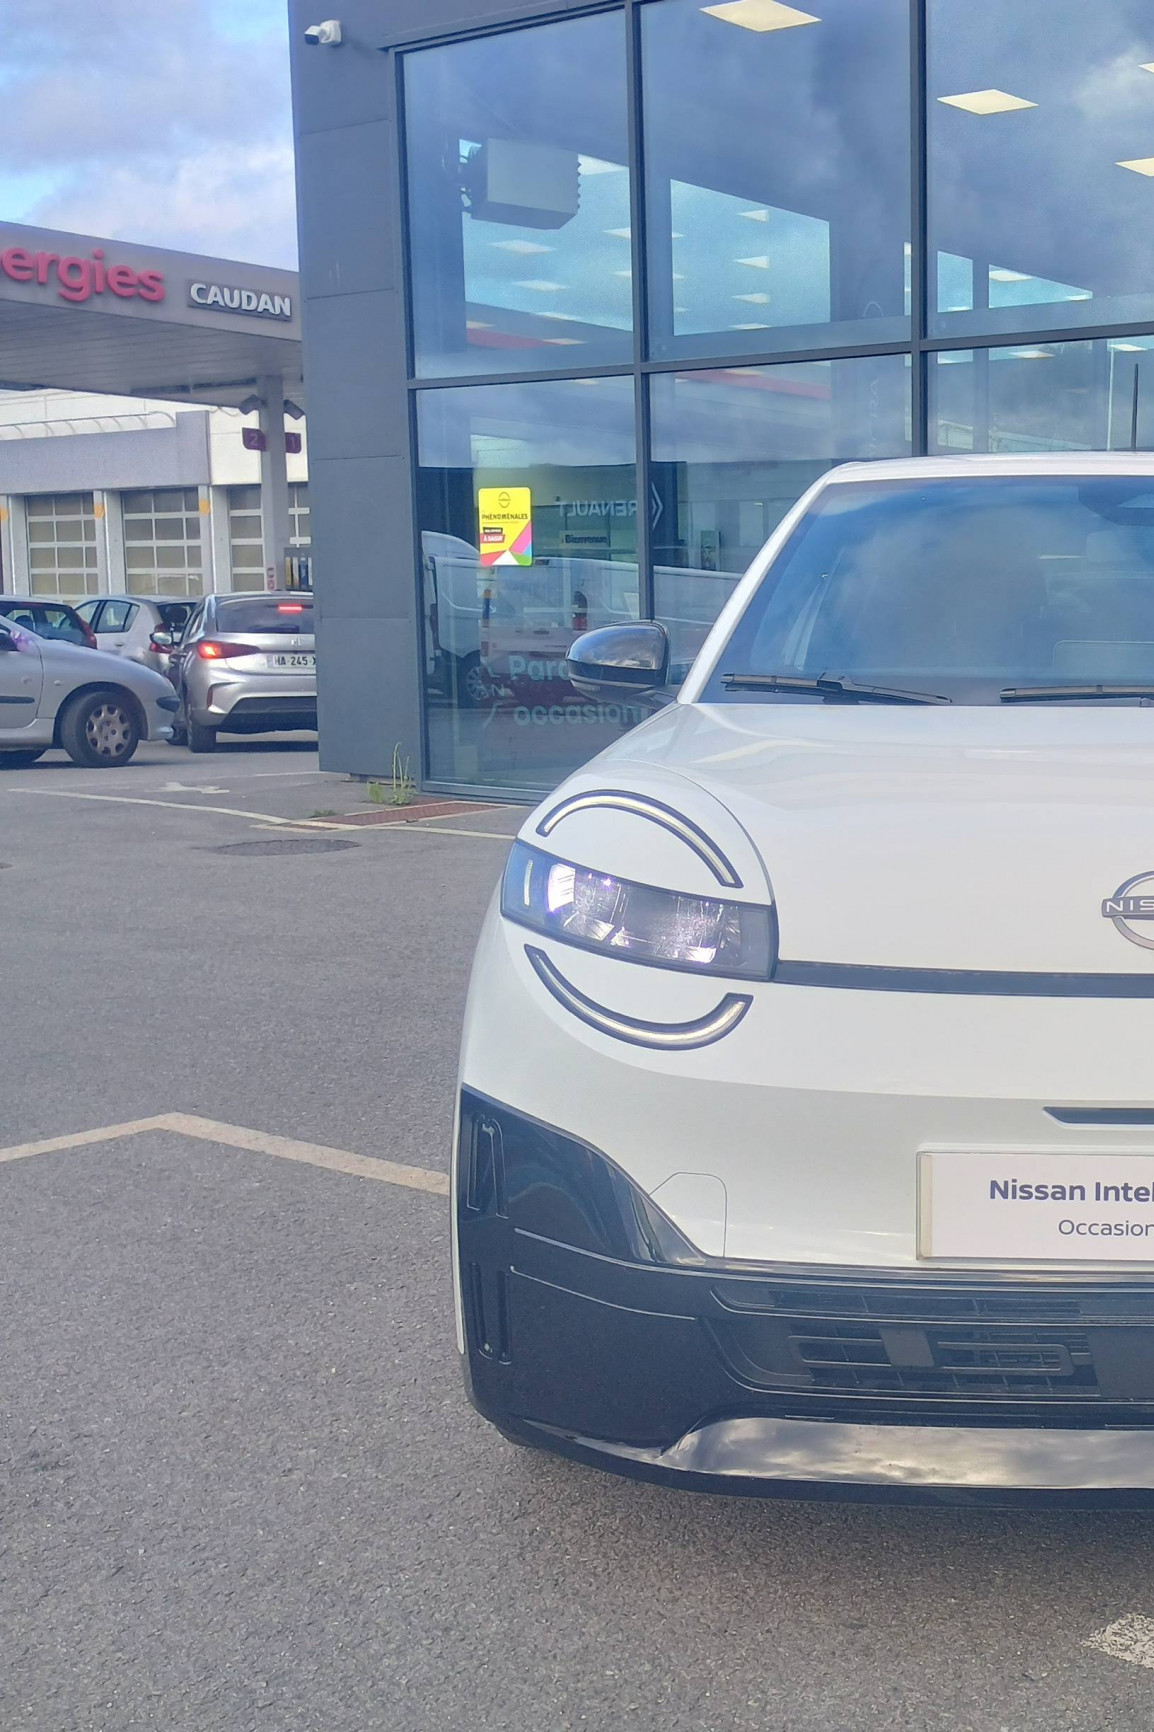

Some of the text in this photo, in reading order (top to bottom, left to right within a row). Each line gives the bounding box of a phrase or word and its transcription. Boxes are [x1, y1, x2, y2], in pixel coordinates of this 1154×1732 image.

[1, 247, 166, 302] ergies
[190, 283, 291, 316] CAUDAN
[249, 433, 258, 446] 2
[989, 1178, 1086, 1201] Nissan
